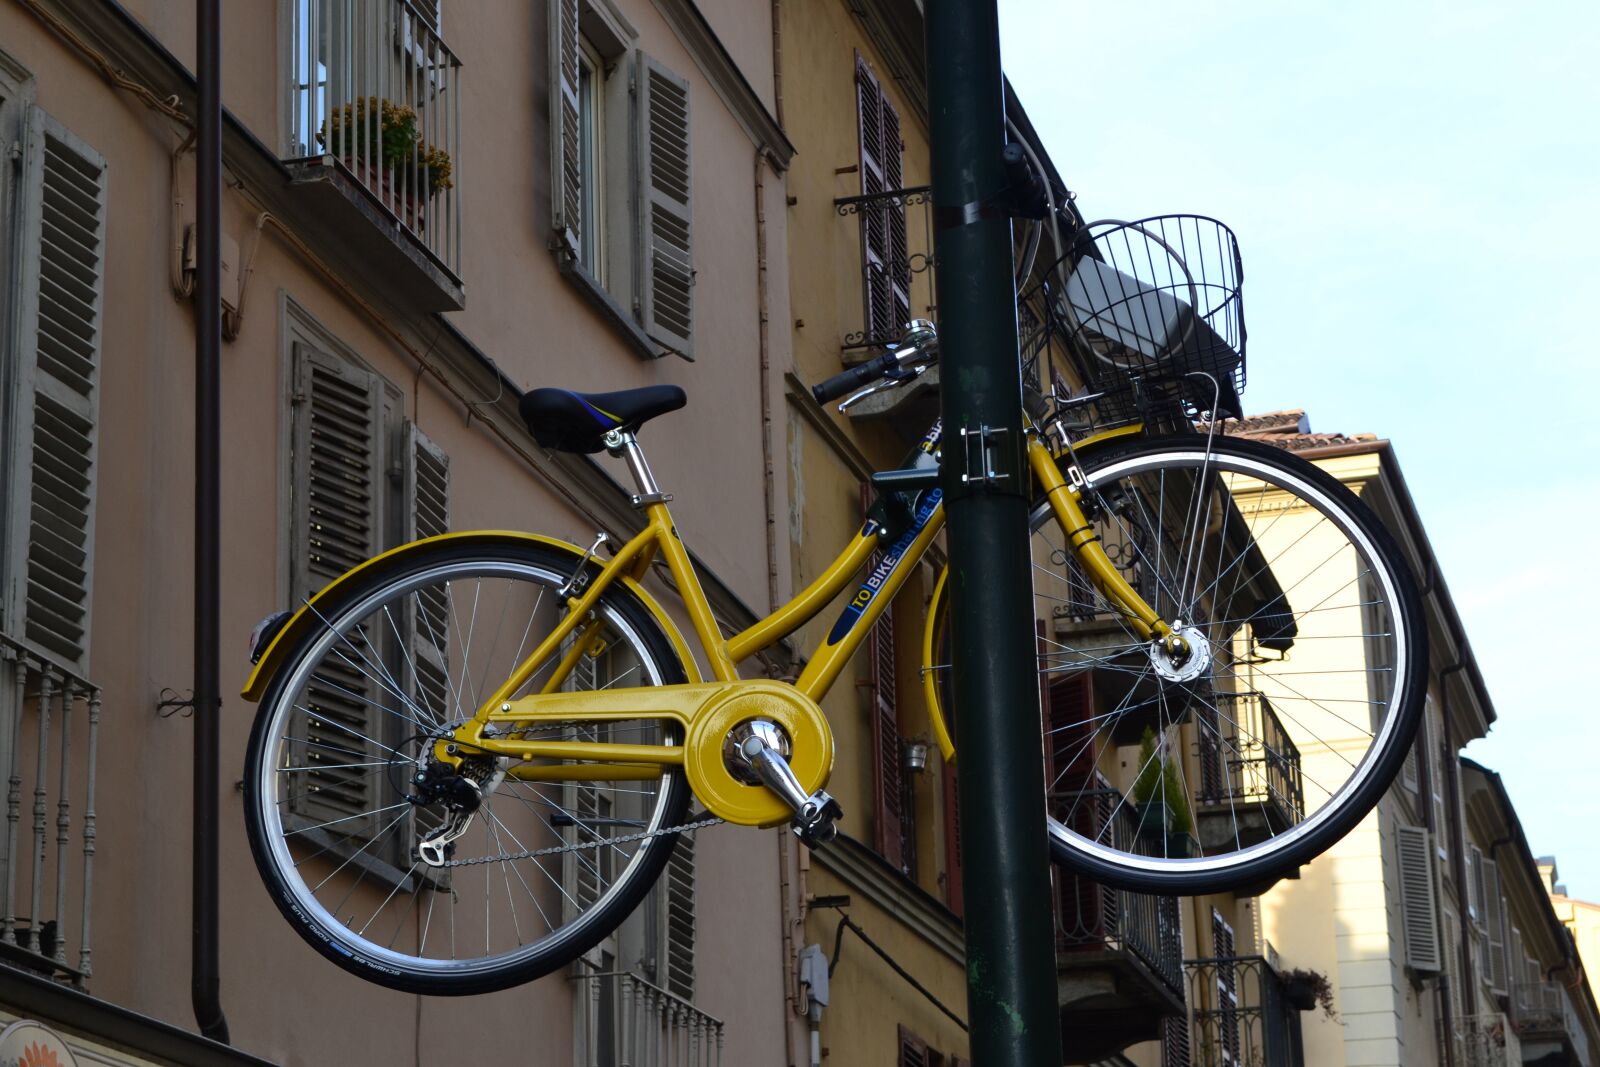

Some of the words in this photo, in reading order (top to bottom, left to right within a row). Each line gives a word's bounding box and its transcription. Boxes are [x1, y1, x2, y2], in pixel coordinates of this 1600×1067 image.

[852, 589, 871, 608] TO
[867, 555, 897, 589] BIKE
[291, 905, 309, 924] PLUS
